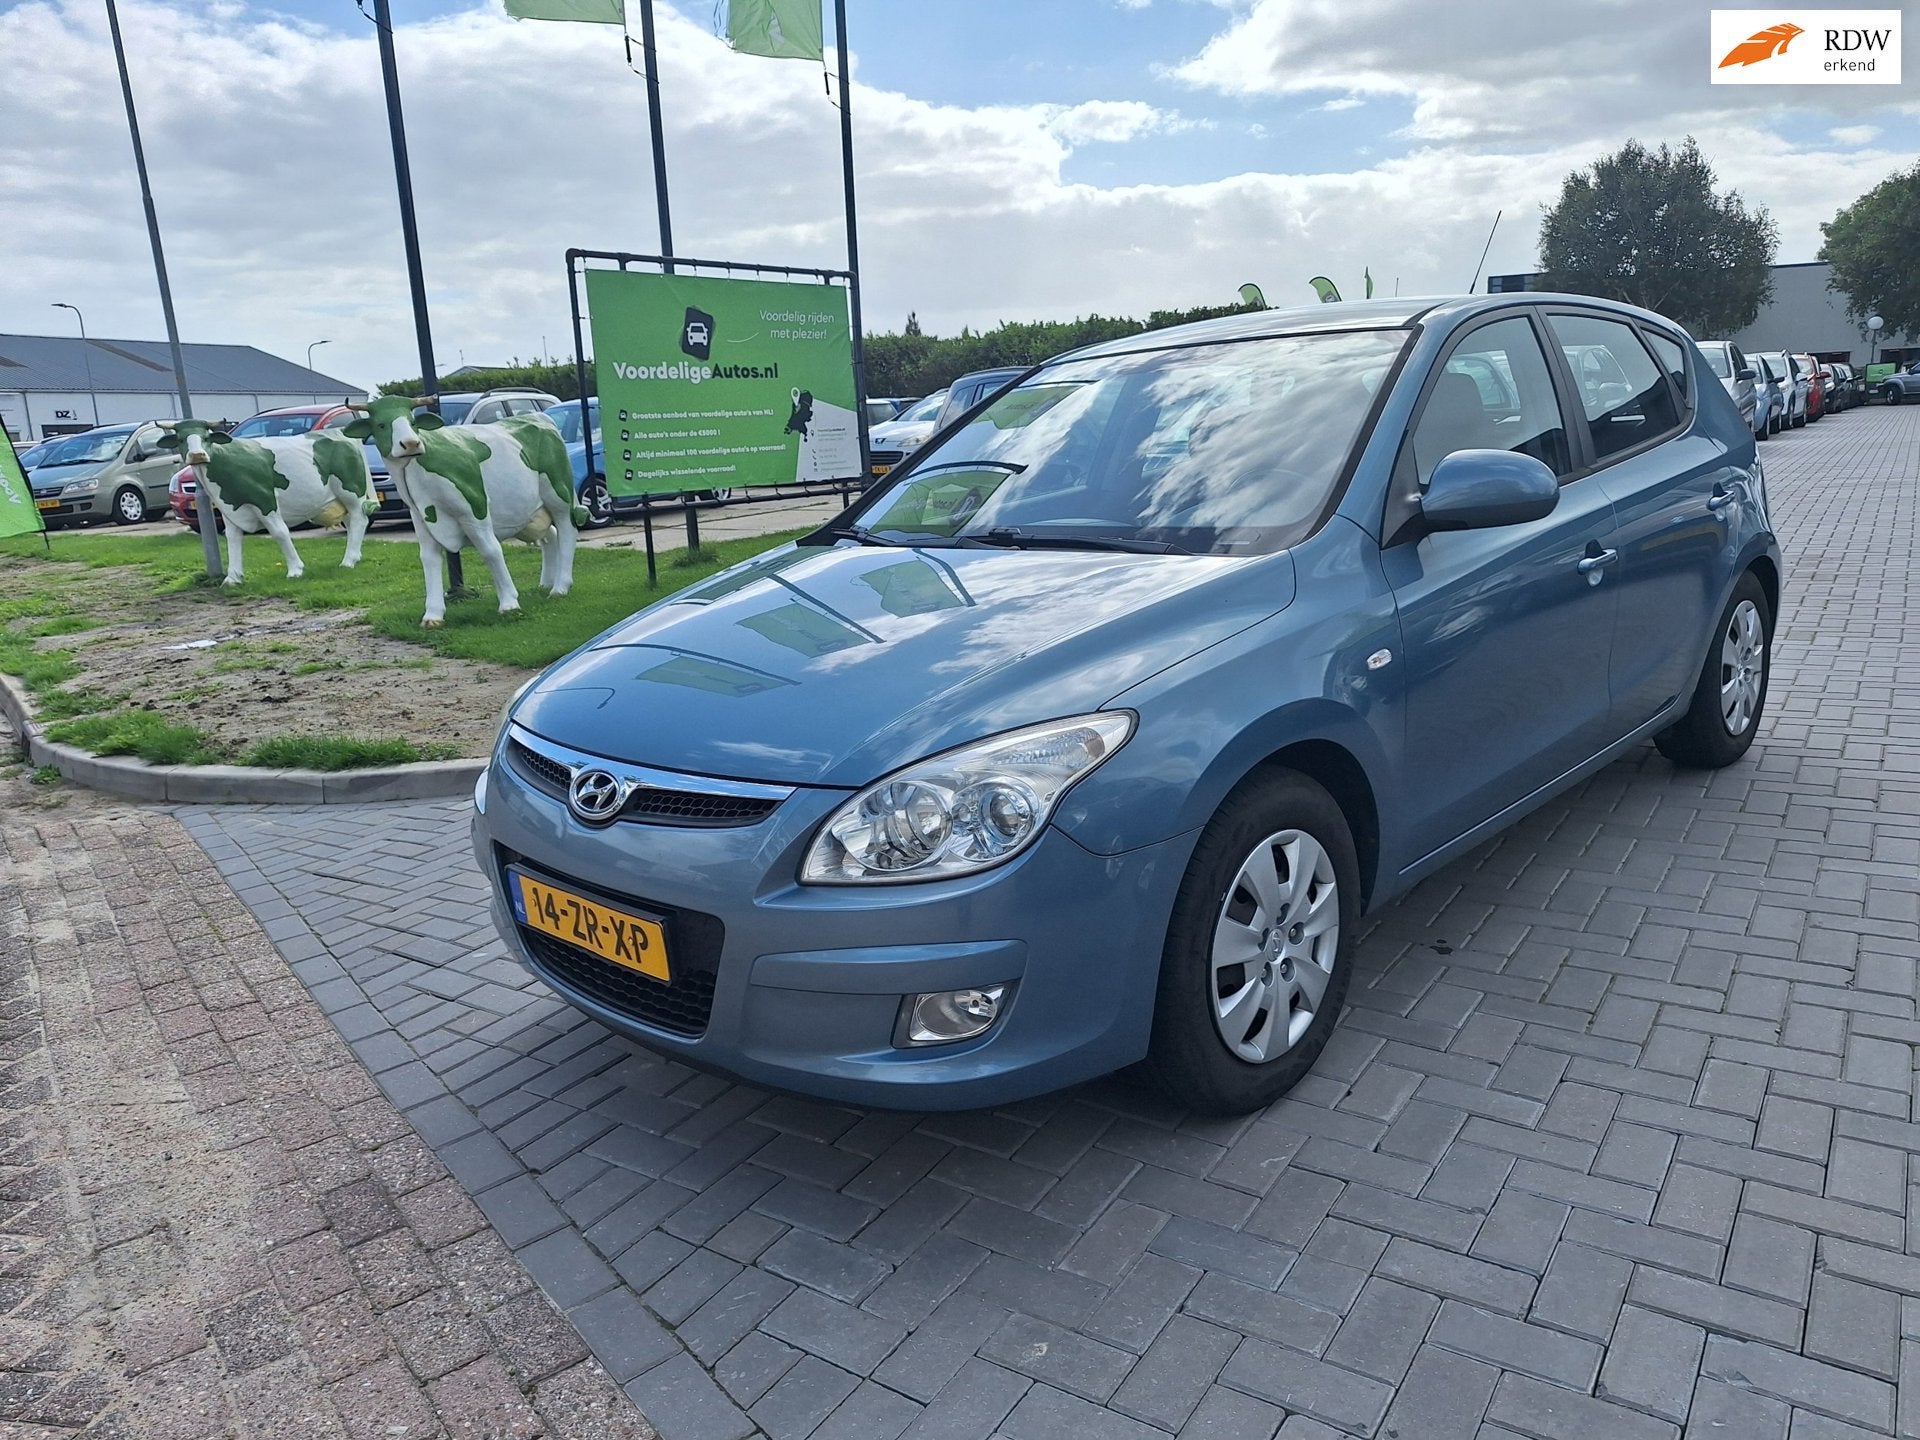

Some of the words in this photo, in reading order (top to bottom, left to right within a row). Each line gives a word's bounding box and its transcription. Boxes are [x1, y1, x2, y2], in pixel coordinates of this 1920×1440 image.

[760, 310, 806, 325] Voordelig
[807, 312, 834, 325] rijden
[770, 329, 790, 338] met
[792, 328, 827, 340] plezier!
[613, 361, 778, 384] VoordeligeAutos.nl
[662, 411, 687, 419] aanbod
[701, 410, 732, 418] voordelige
[634, 431, 648, 439] Alle
[636, 450, 655, 459] Altijd
[655, 449, 686, 457] minimaal
[698, 447, 731, 455] voordelige
[638, 469, 670, 478] Dagelijks
[670, 467, 706, 475] wisselende
[532, 887, 649, 963] 14-ZR-XP
